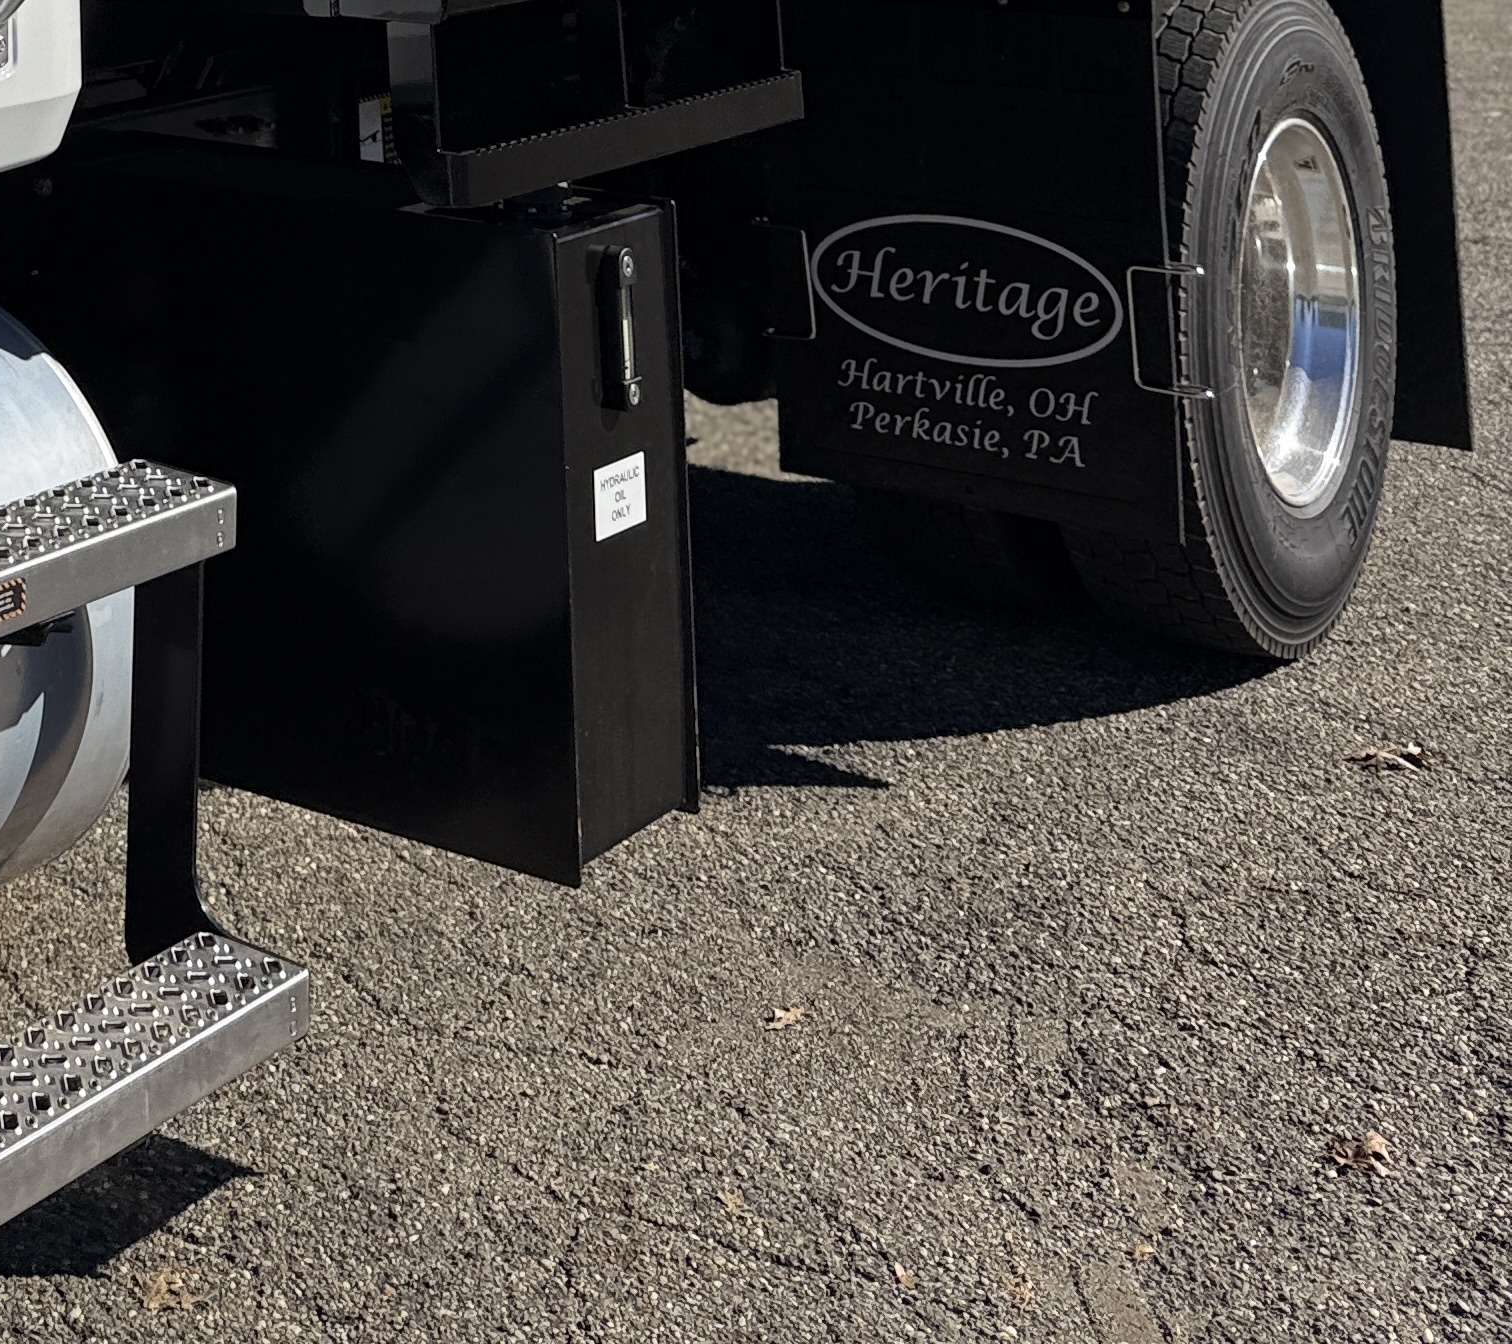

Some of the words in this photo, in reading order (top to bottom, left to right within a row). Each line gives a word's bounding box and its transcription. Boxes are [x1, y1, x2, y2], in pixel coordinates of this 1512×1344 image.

[830, 247, 1102, 341] Heritage
[837, 358, 1015, 416] Hartville,
[1028, 387, 1099, 425] OH
[849, 401, 1009, 459] Perkasie,
[1023, 429, 1086, 468] PA
[600, 466, 640, 492] HYDRAULIC
[614, 489, 627, 503] OIL
[611, 504, 631, 522] ONLY
